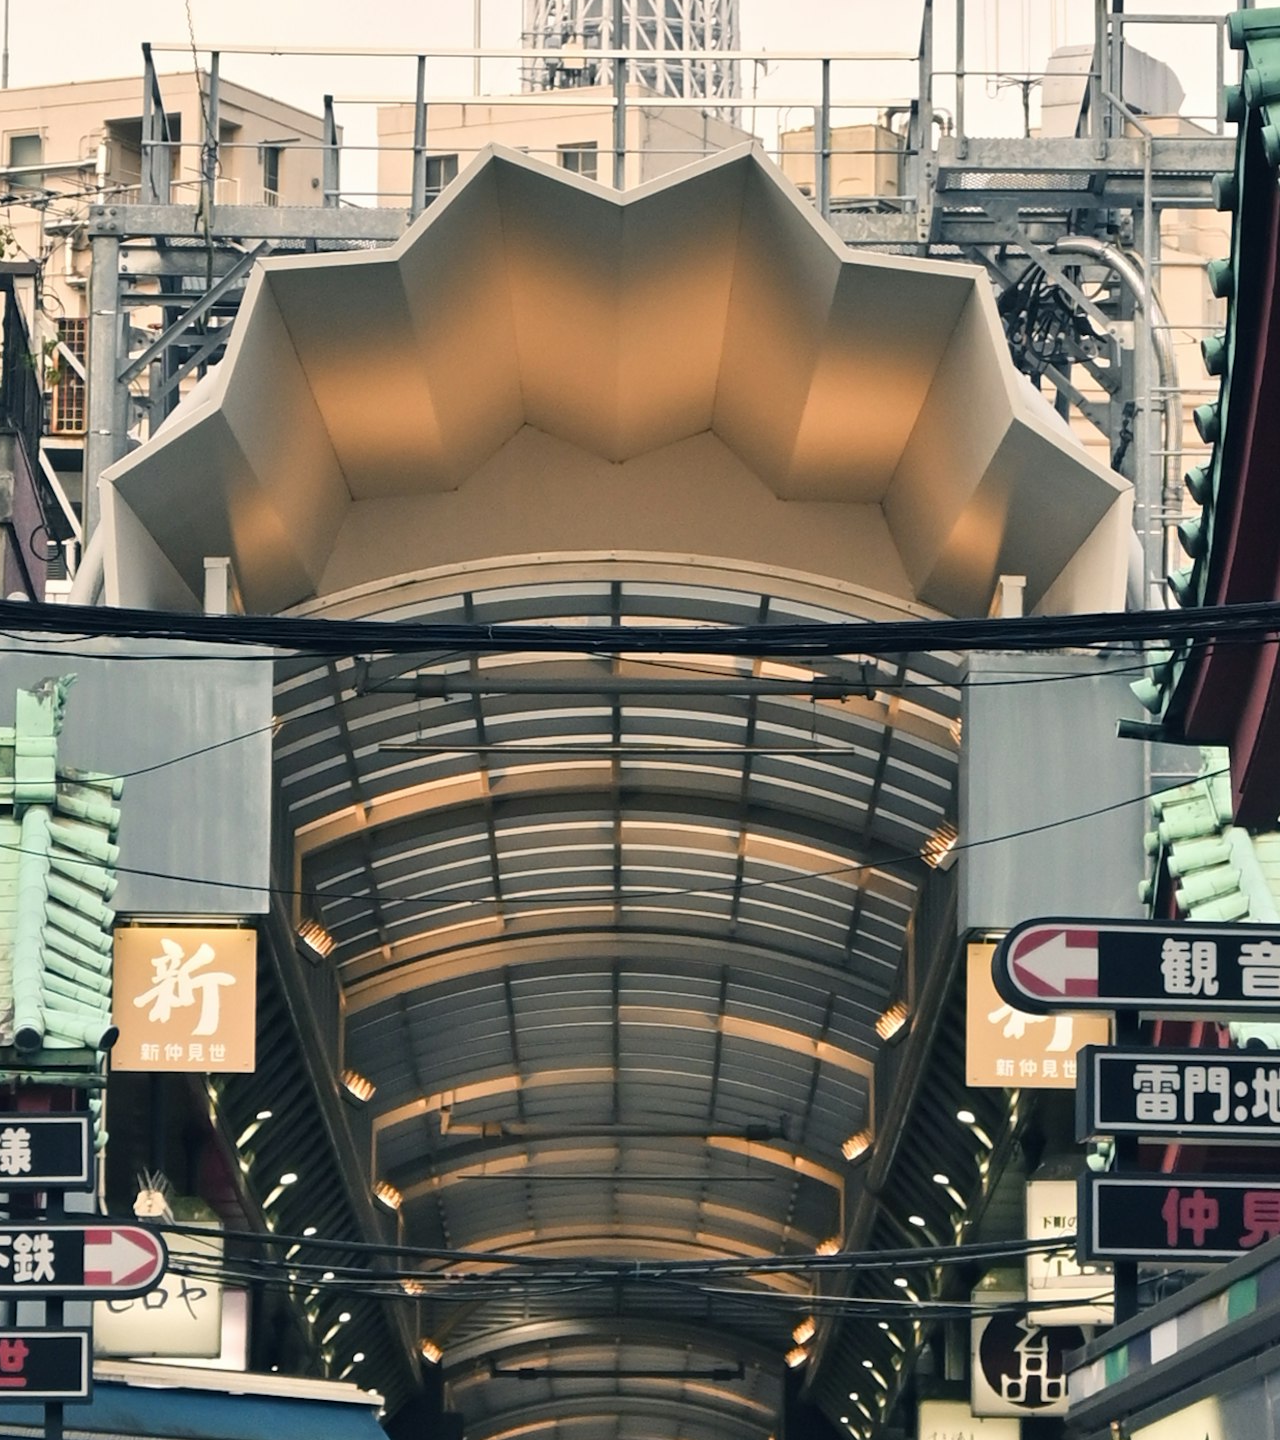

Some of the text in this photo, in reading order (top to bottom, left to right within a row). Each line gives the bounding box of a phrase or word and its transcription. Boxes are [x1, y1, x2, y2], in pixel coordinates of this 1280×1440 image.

[133, 938, 236, 1035] 新
[139, 1042, 227, 1062] 新仲見世
